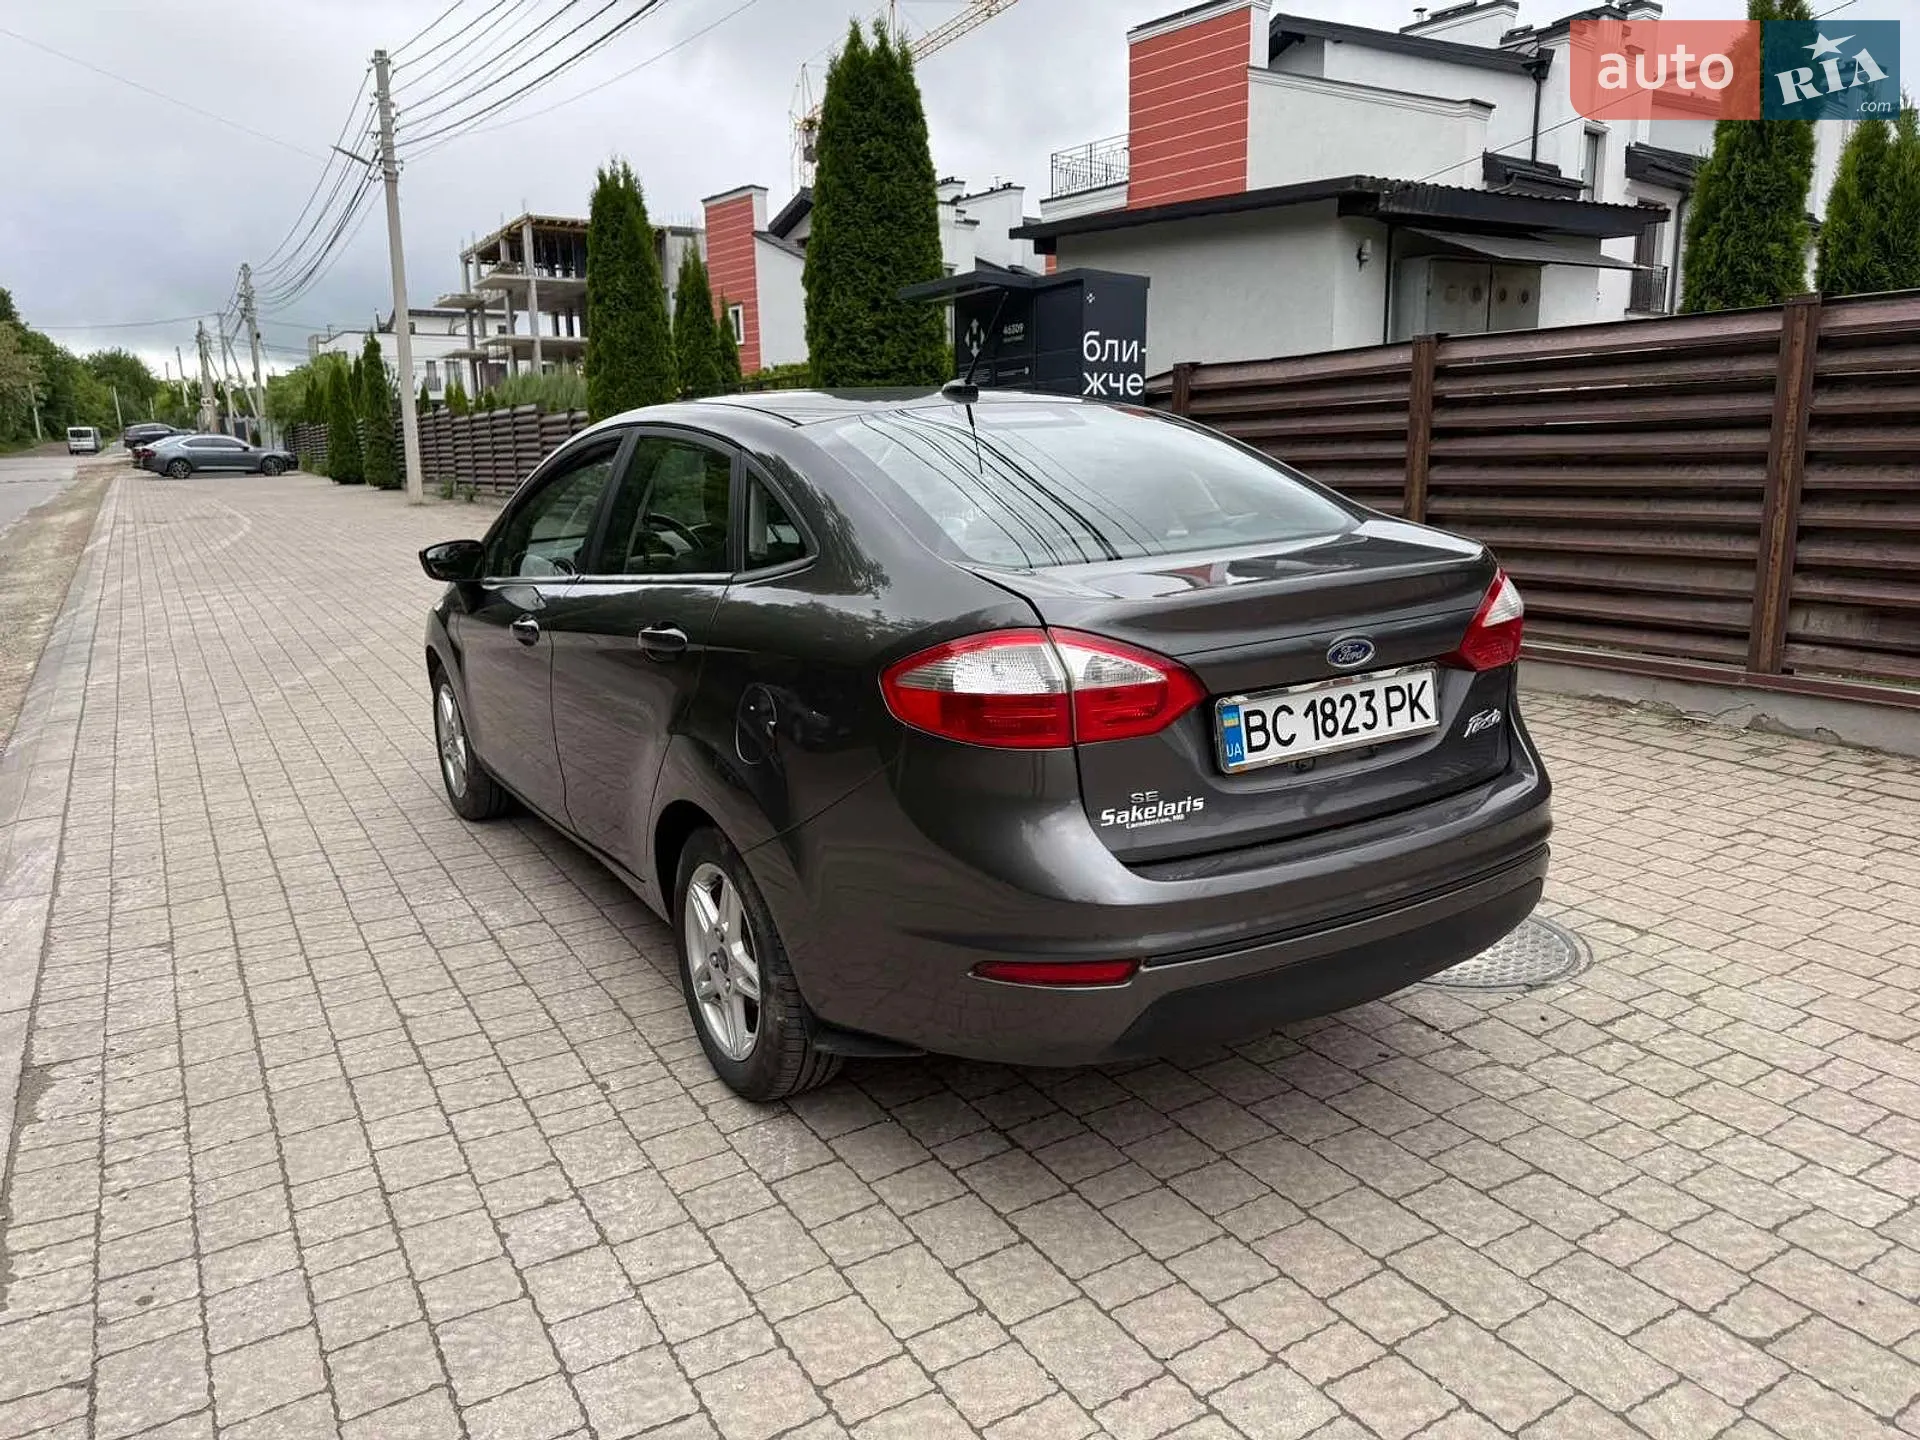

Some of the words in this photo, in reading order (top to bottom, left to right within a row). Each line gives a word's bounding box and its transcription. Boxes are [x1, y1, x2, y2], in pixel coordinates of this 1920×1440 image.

[1083, 372, 1144, 396] жче
[1243, 704, 1297, 753] BC
[1303, 690, 1378, 741] 1823
[1385, 679, 1431, 727] PK
[1226, 743, 1243, 758] UA
[1129, 790, 1159, 804] SE
[1100, 796, 1205, 827] Sakelaris
